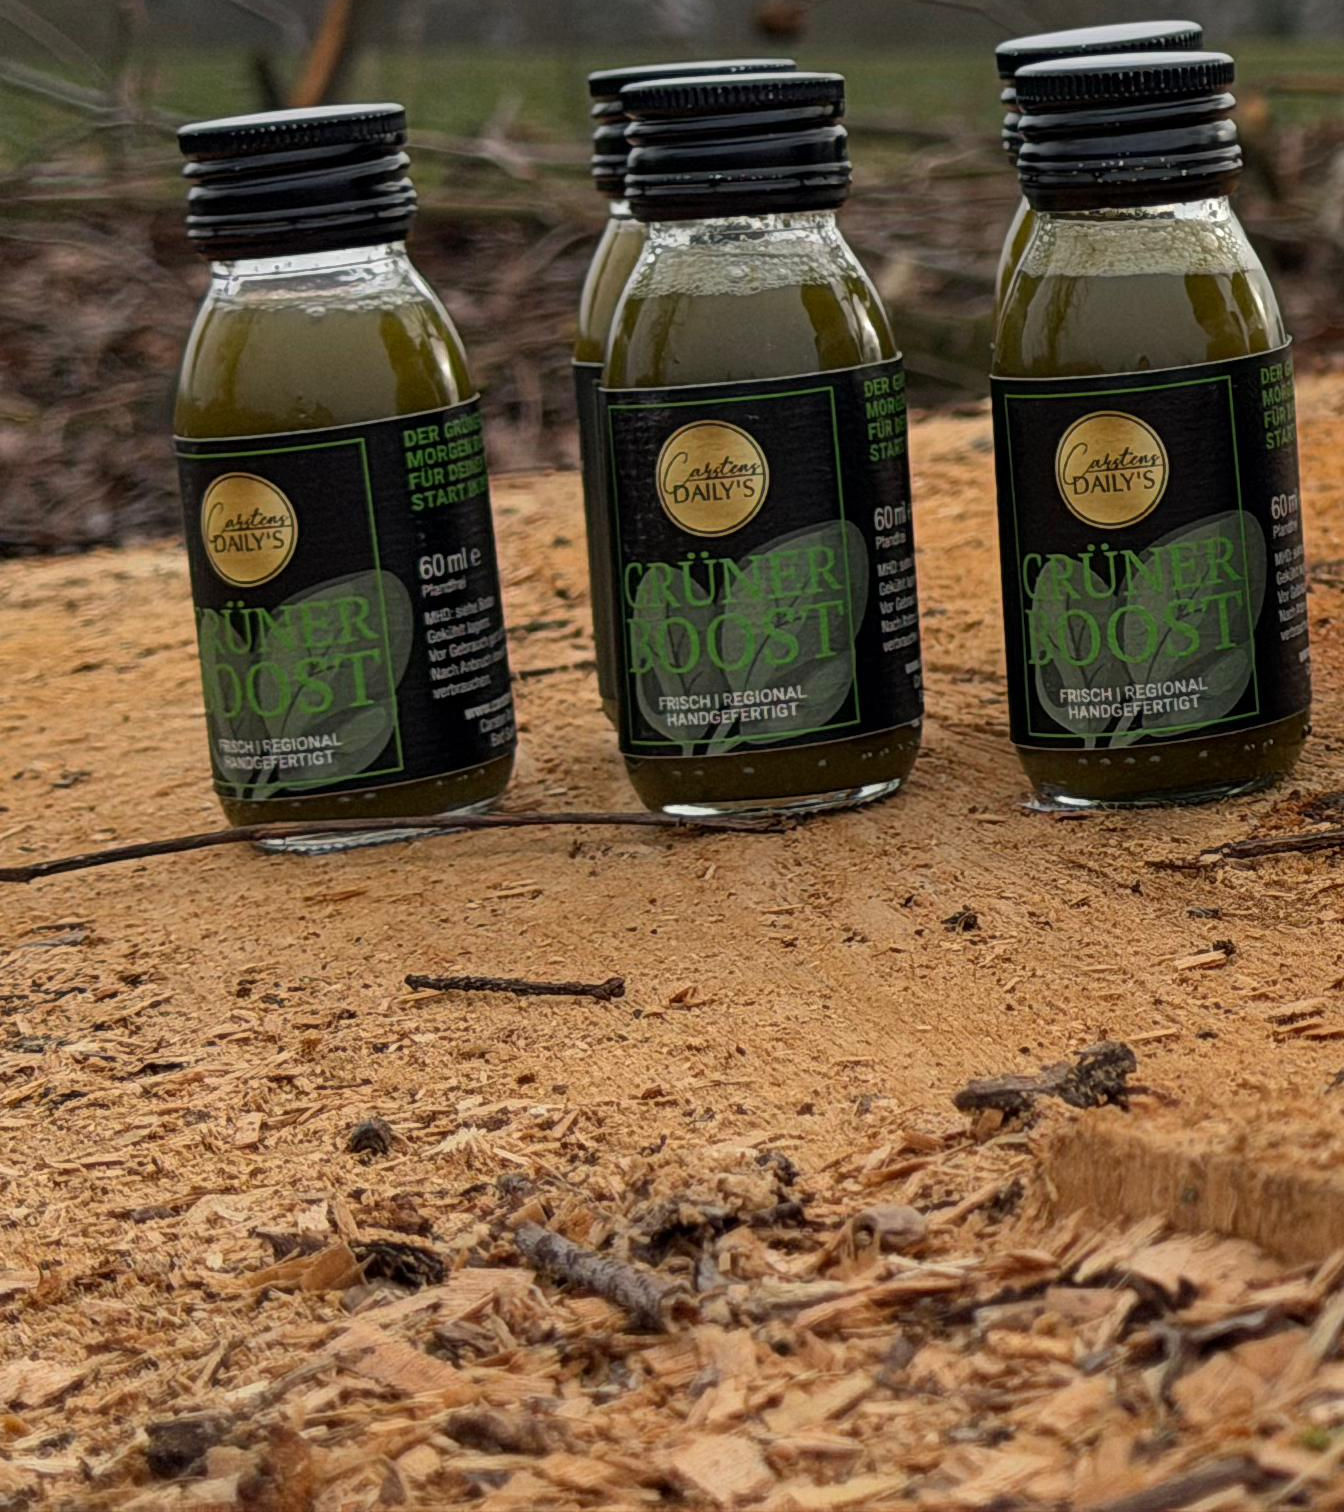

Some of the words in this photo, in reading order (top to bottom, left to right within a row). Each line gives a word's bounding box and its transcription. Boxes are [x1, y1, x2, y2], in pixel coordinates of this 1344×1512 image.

[864, 377, 889, 397] DER
[403, 425, 440, 447] DER
[868, 417, 893, 440] FÜR
[663, 451, 762, 494] Carstens
[1063, 443, 1161, 486] Carstens
[408, 467, 445, 490] FÜR
[672, 478, 756, 504] DAILY'S
[1073, 471, 1156, 496] DAILY'S
[411, 483, 466, 510] START
[1271, 493, 1287, 519] 60
[207, 502, 289, 544] Carstens
[874, 505, 893, 531] 60
[213, 530, 285, 553] DAILY'S
[419, 553, 445, 579] 60
[447, 547, 468, 573] ml
[1022, 535, 1246, 603] GRÜNER
[625, 546, 843, 609] GRÜNER
[196, 595, 379, 654] RÜNER
[626, 600, 845, 673] BOOST
[1025, 590, 1243, 668] BOOST
[658, 694, 712, 711] FRISCH
[723, 685, 809, 707] REGIONAL
[1059, 687, 1112, 704] FRISCH
[1125, 677, 1208, 700] REGIONAL
[666, 701, 799, 727] HANDGEFERTIGT
[1068, 694, 1200, 720] HANDGEFERTIGT
[263, 733, 343, 752] REGIONAL
